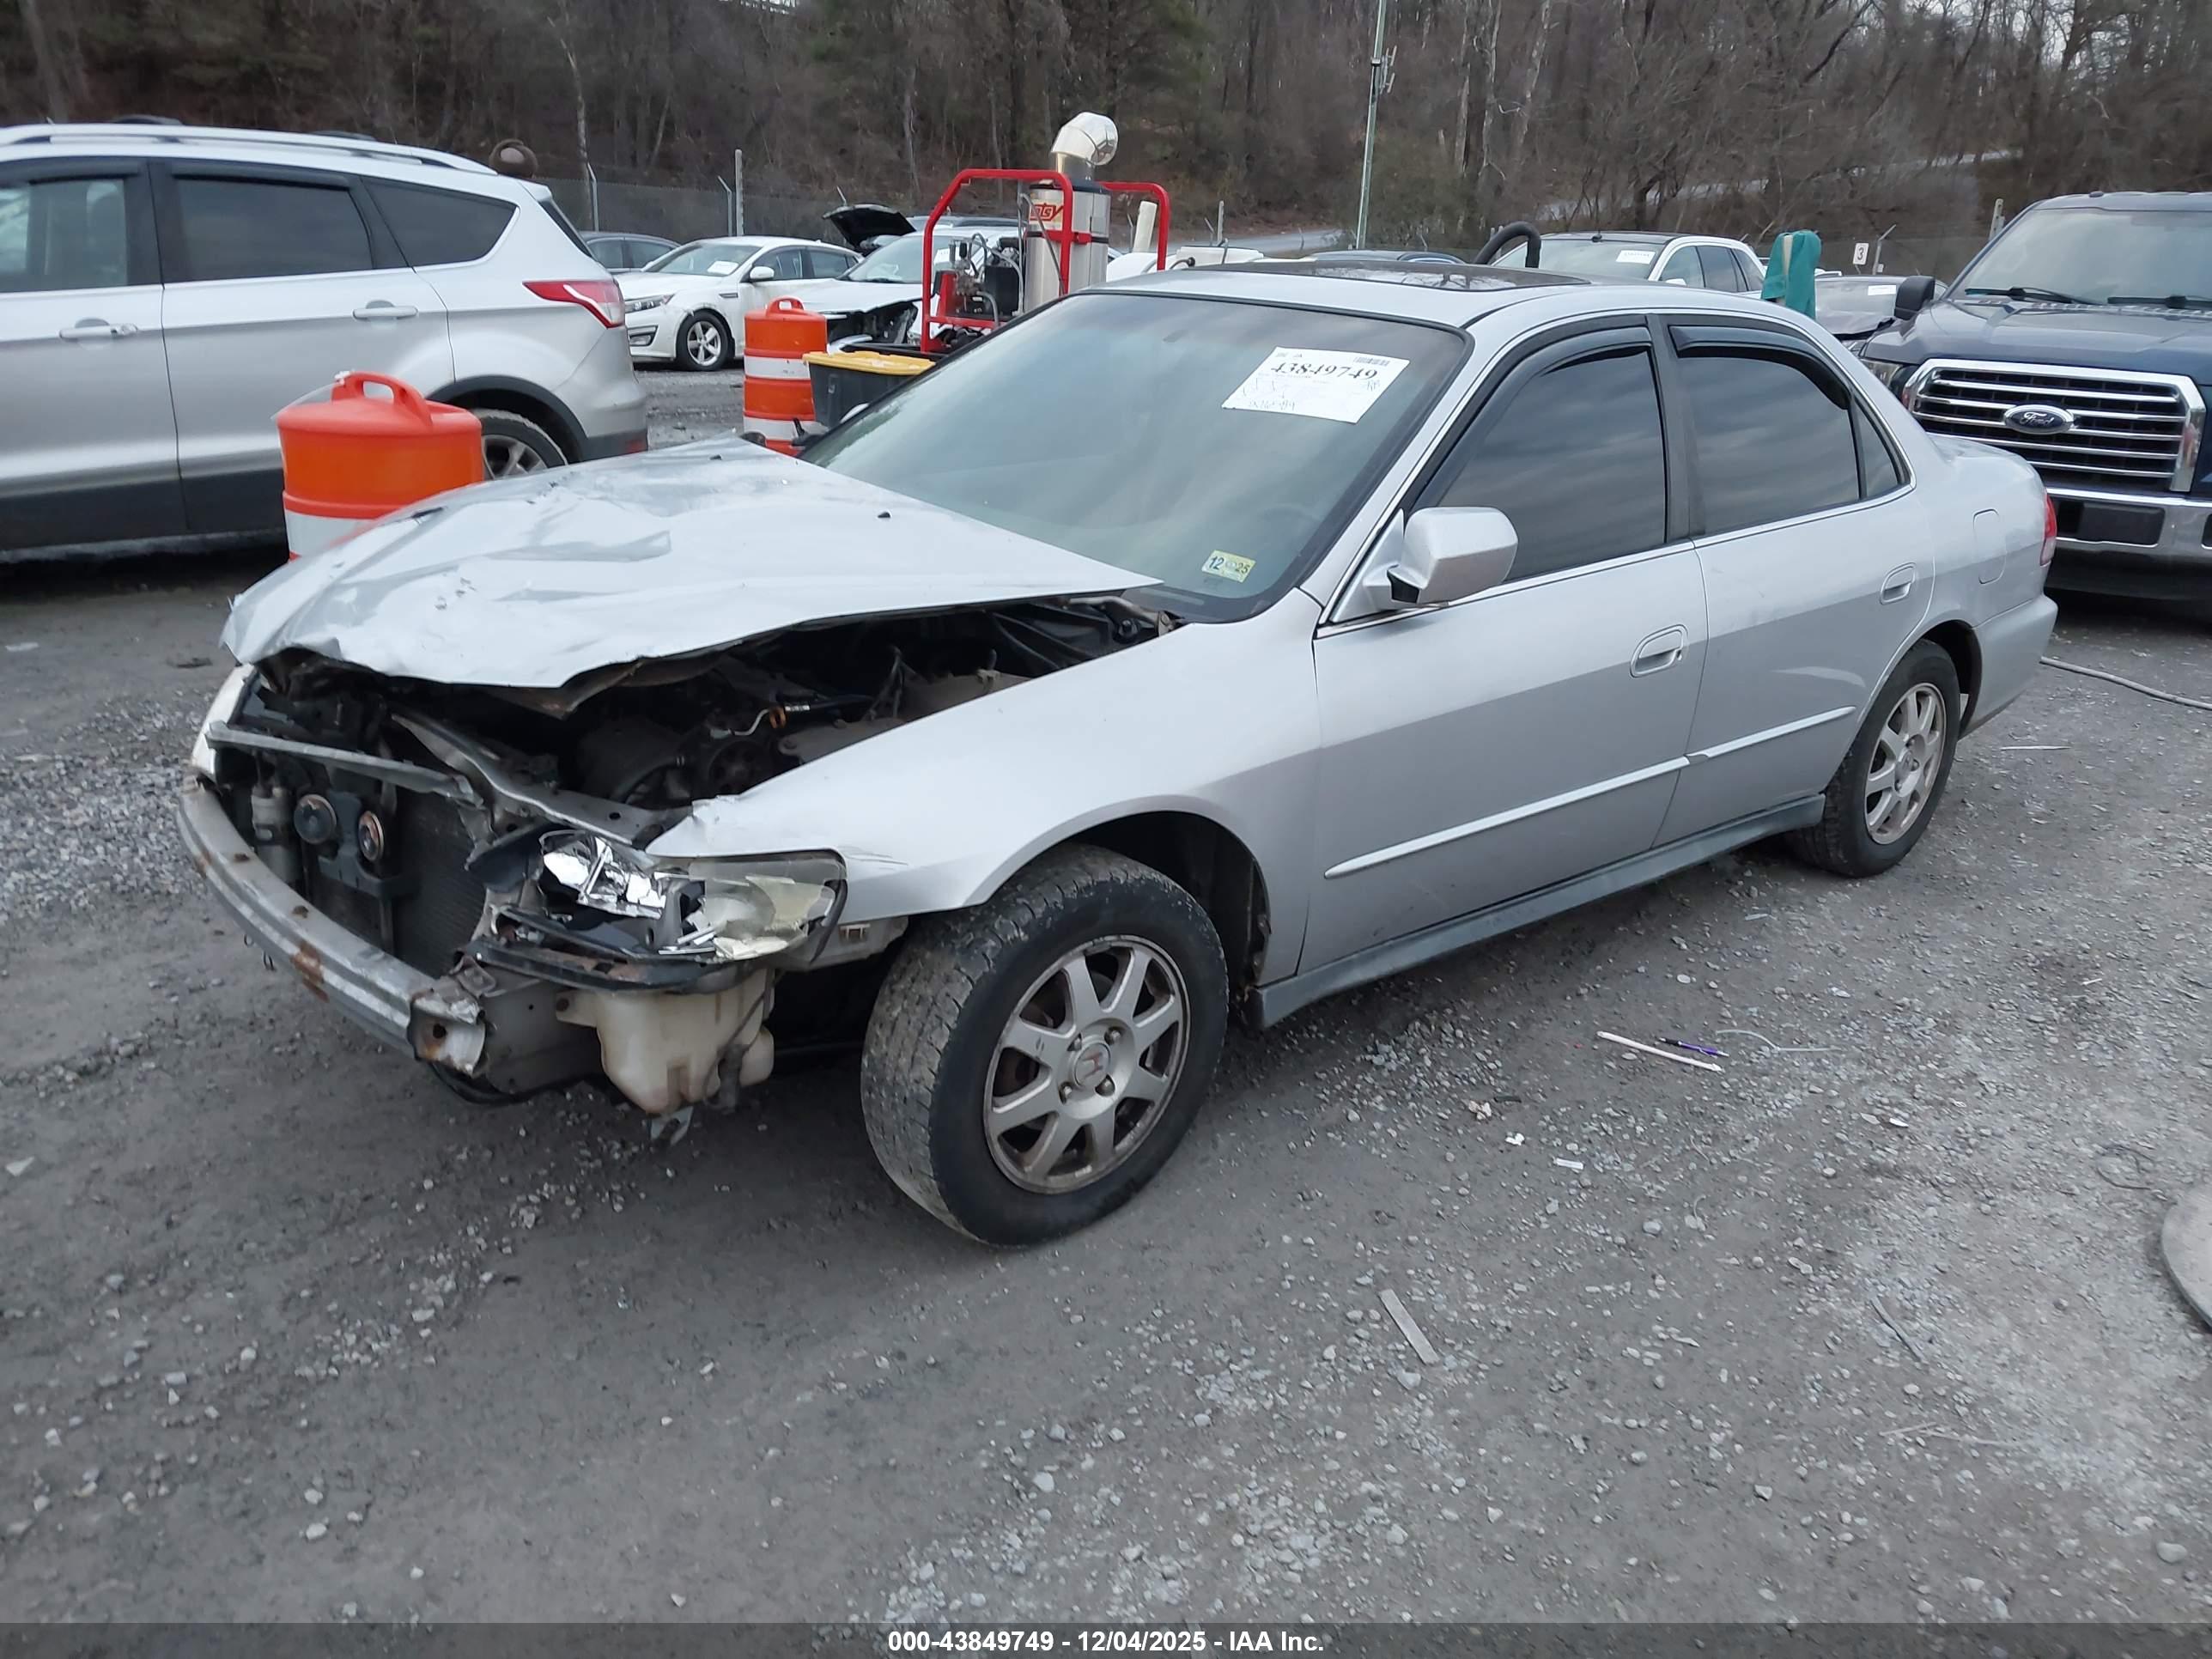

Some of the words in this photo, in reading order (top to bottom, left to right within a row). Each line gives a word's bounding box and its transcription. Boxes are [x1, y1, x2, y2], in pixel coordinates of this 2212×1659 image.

[1857, 246, 1864, 261] 3
[1271, 361, 1378, 380] 43849749
[2019, 411, 2055, 426] Ford
[1209, 556, 1224, 570] 12
